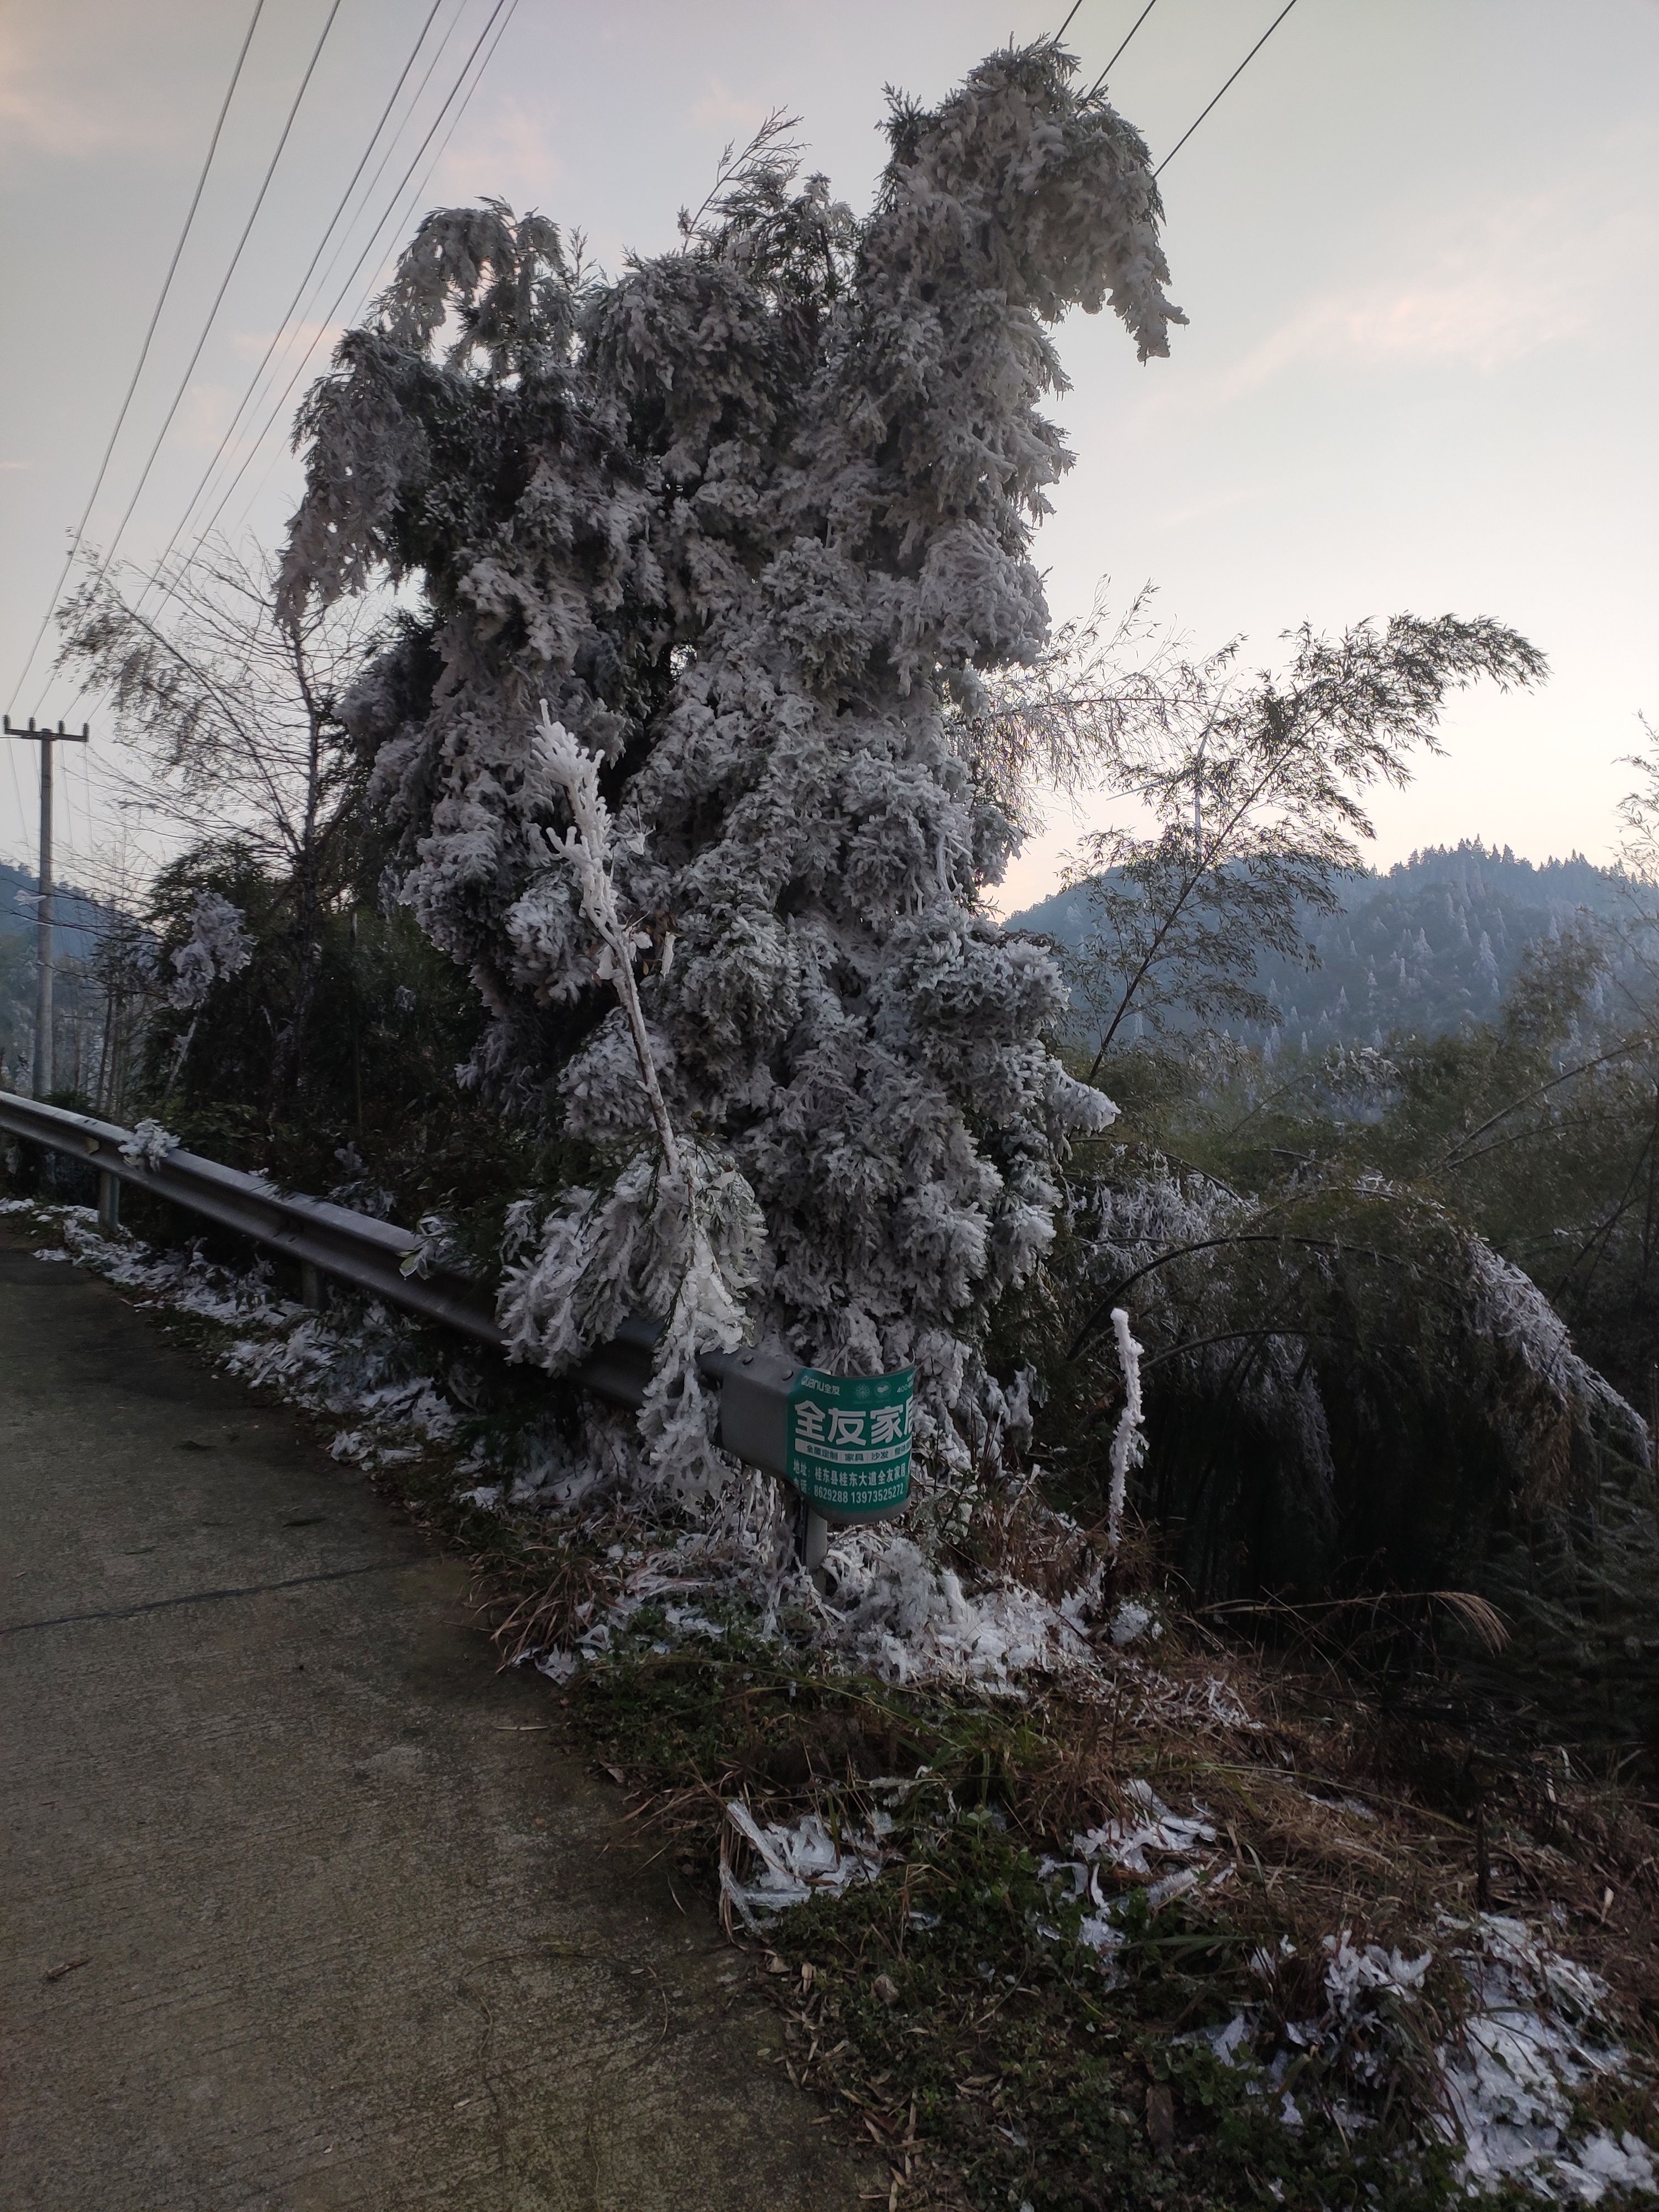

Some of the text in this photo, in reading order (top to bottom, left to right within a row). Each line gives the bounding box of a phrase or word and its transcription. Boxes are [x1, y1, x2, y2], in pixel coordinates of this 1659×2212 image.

[807, 1445, 838, 1460] 全屋定制
[844, 1453, 864, 1462] 家具
[871, 1451, 889, 1460] 沙发
[851, 1483, 904, 1504] 13973525272
